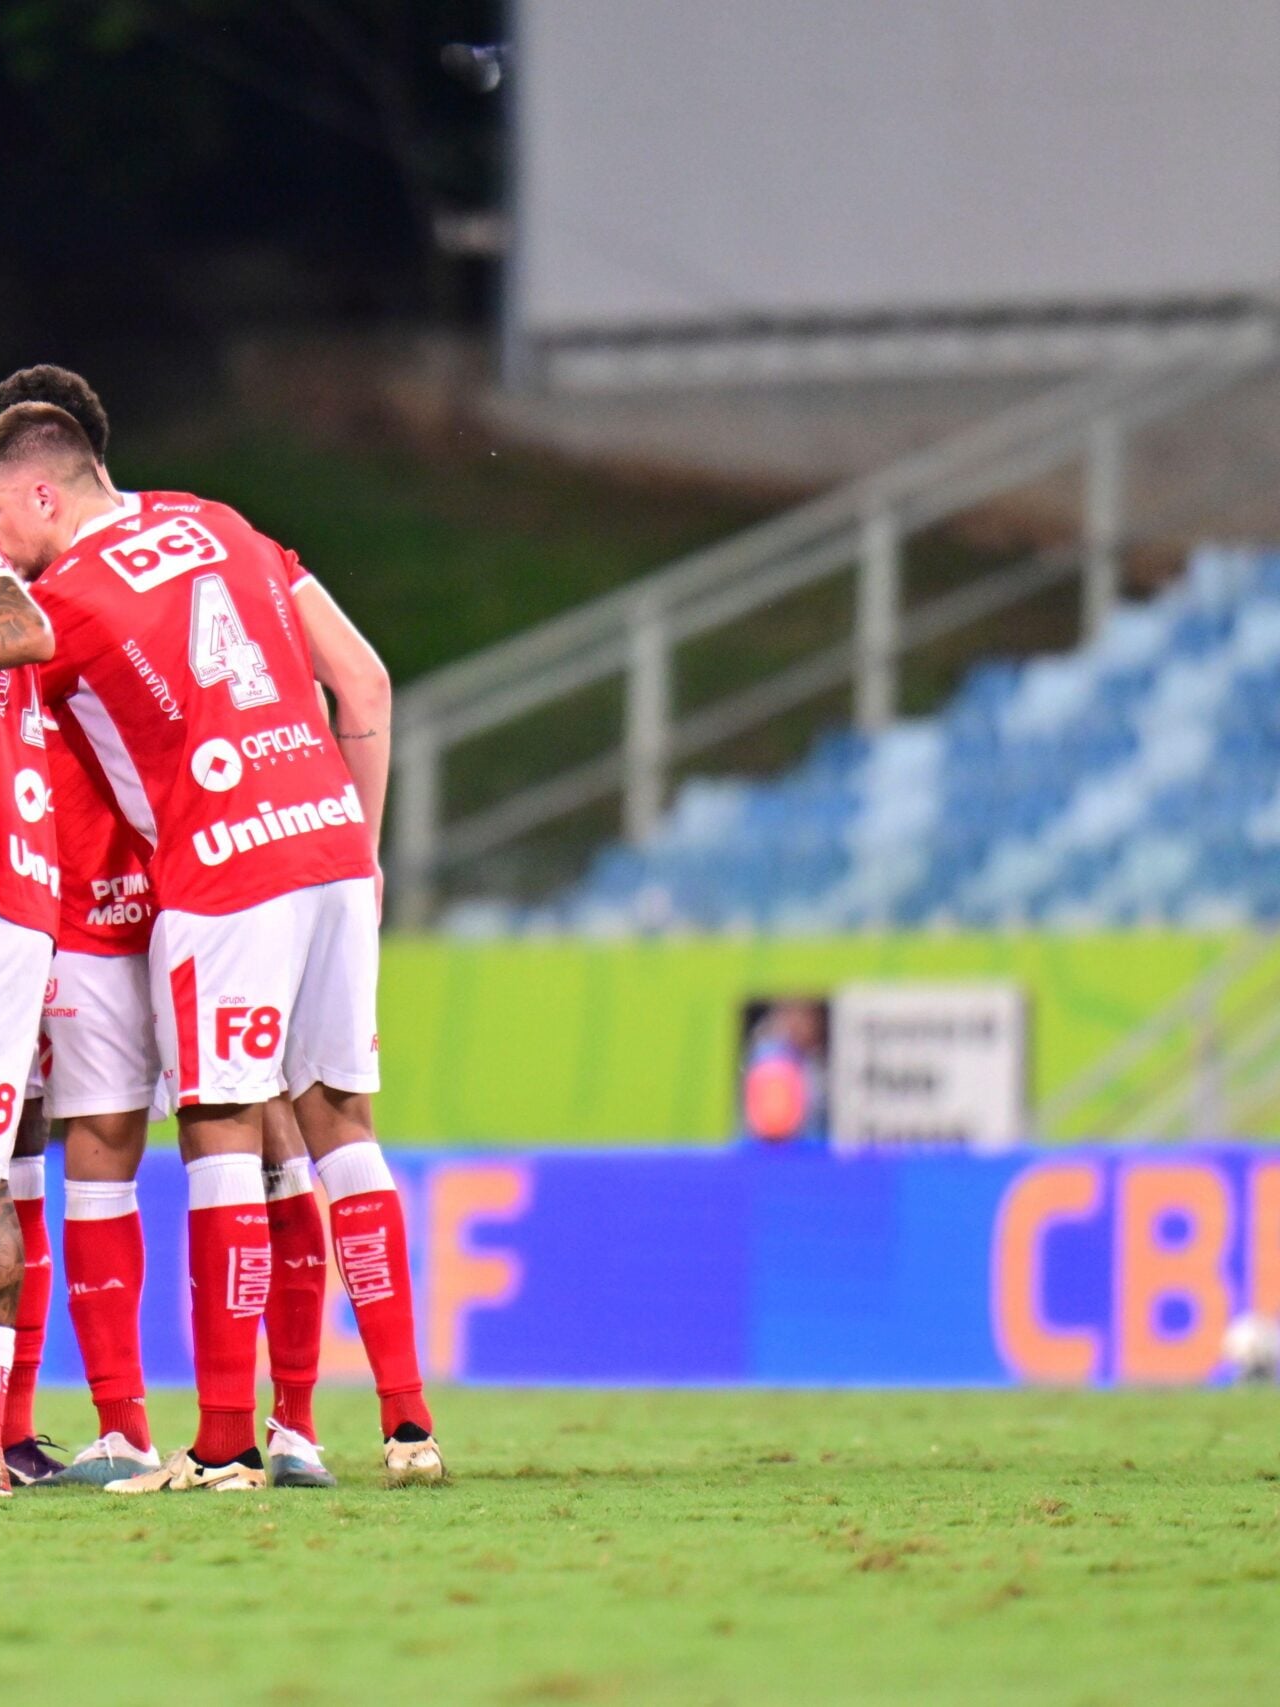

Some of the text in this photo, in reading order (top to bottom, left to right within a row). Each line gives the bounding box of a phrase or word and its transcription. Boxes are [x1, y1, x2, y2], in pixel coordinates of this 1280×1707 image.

[109, 519, 217, 578] bcj
[188, 573, 280, 711] 4
[122, 639, 183, 721] AQUARIUS
[241, 722, 322, 760] OFICIAL
[253, 746, 325, 771] SPORT
[192, 784, 365, 866] Unimed
[218, 995, 246, 1005] Grupo
[215, 1005, 282, 1061] F8
[284, 1254, 326, 1269] VIL
[336, 1226, 394, 1307] VEDACIL
